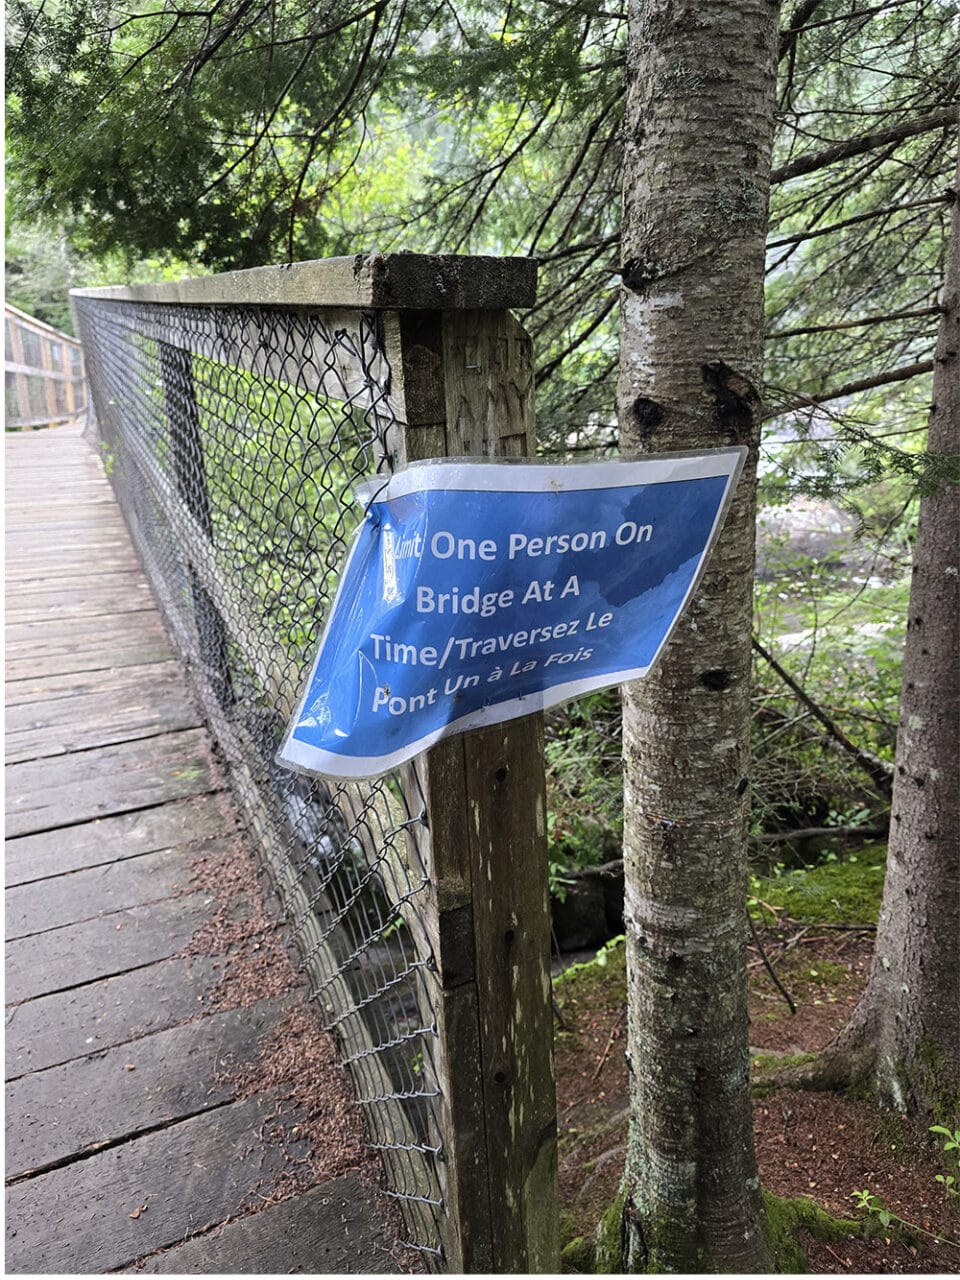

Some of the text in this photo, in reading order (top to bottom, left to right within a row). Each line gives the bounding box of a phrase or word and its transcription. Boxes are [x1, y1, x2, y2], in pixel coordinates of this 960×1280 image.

[431, 531, 497, 561] One
[509, 529, 606, 560] Person
[615, 521, 653, 546] On
[416, 575, 581, 617] Bridge At A
[370, 610, 614, 669] Time/Traversez Le
[371, 645, 594, 715] Pont Un à La Fois
